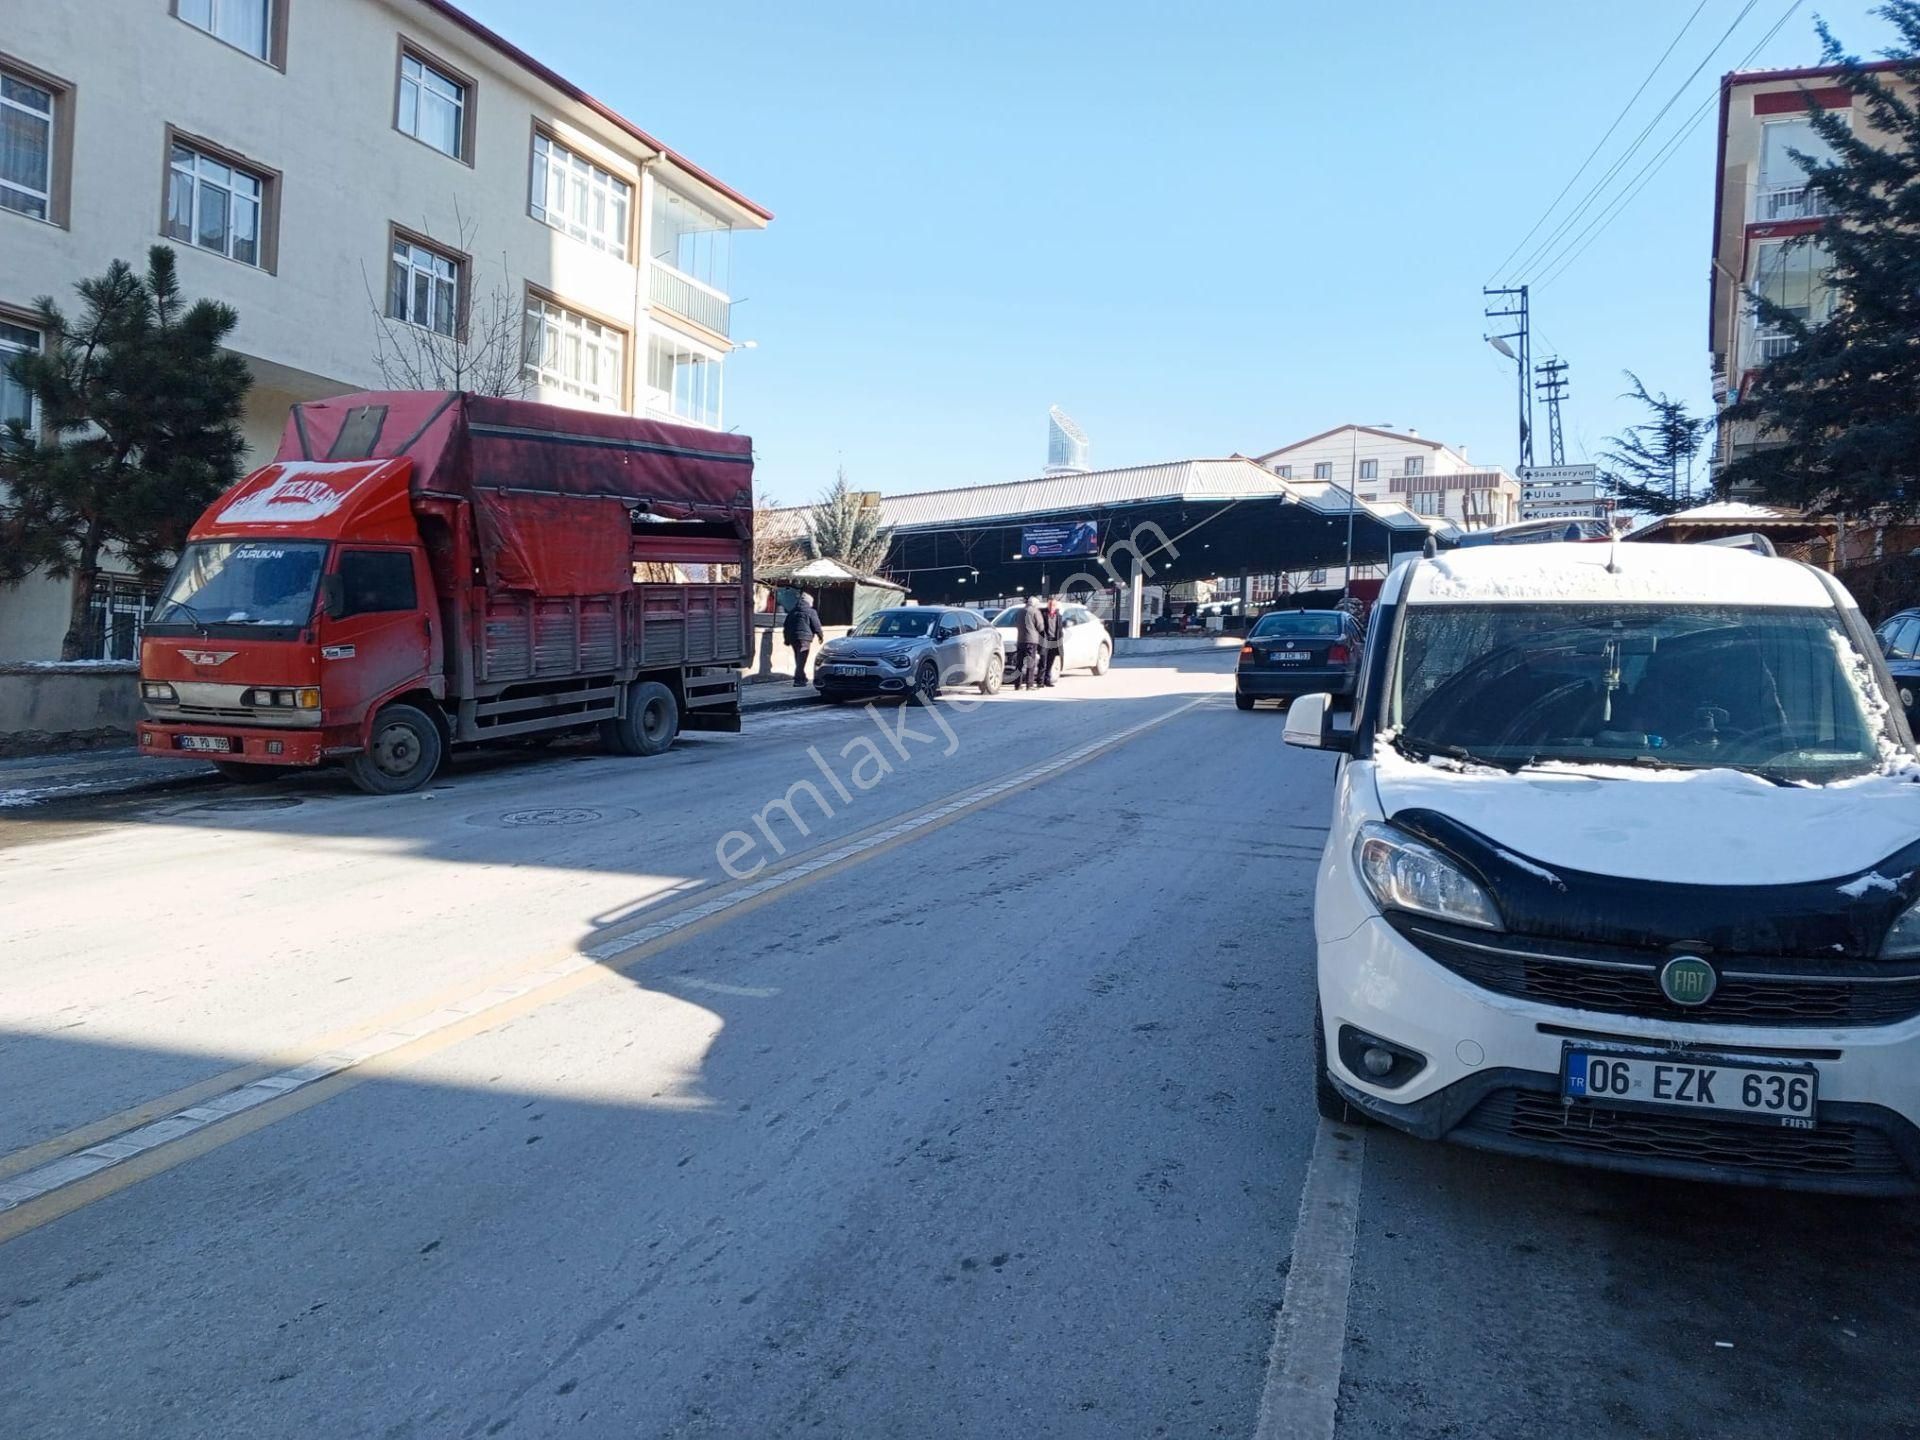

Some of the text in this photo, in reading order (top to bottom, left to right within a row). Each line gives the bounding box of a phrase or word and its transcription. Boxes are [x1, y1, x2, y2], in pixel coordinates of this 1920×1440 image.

[1534, 490, 1561, 498] Ulus
[236, 549, 285, 559] DURUKAN
[1675, 970, 1706, 993] FIAT
[1570, 1059, 1810, 1112] TR 06 EZK 636
[1781, 1117, 1816, 1129] FIAT
